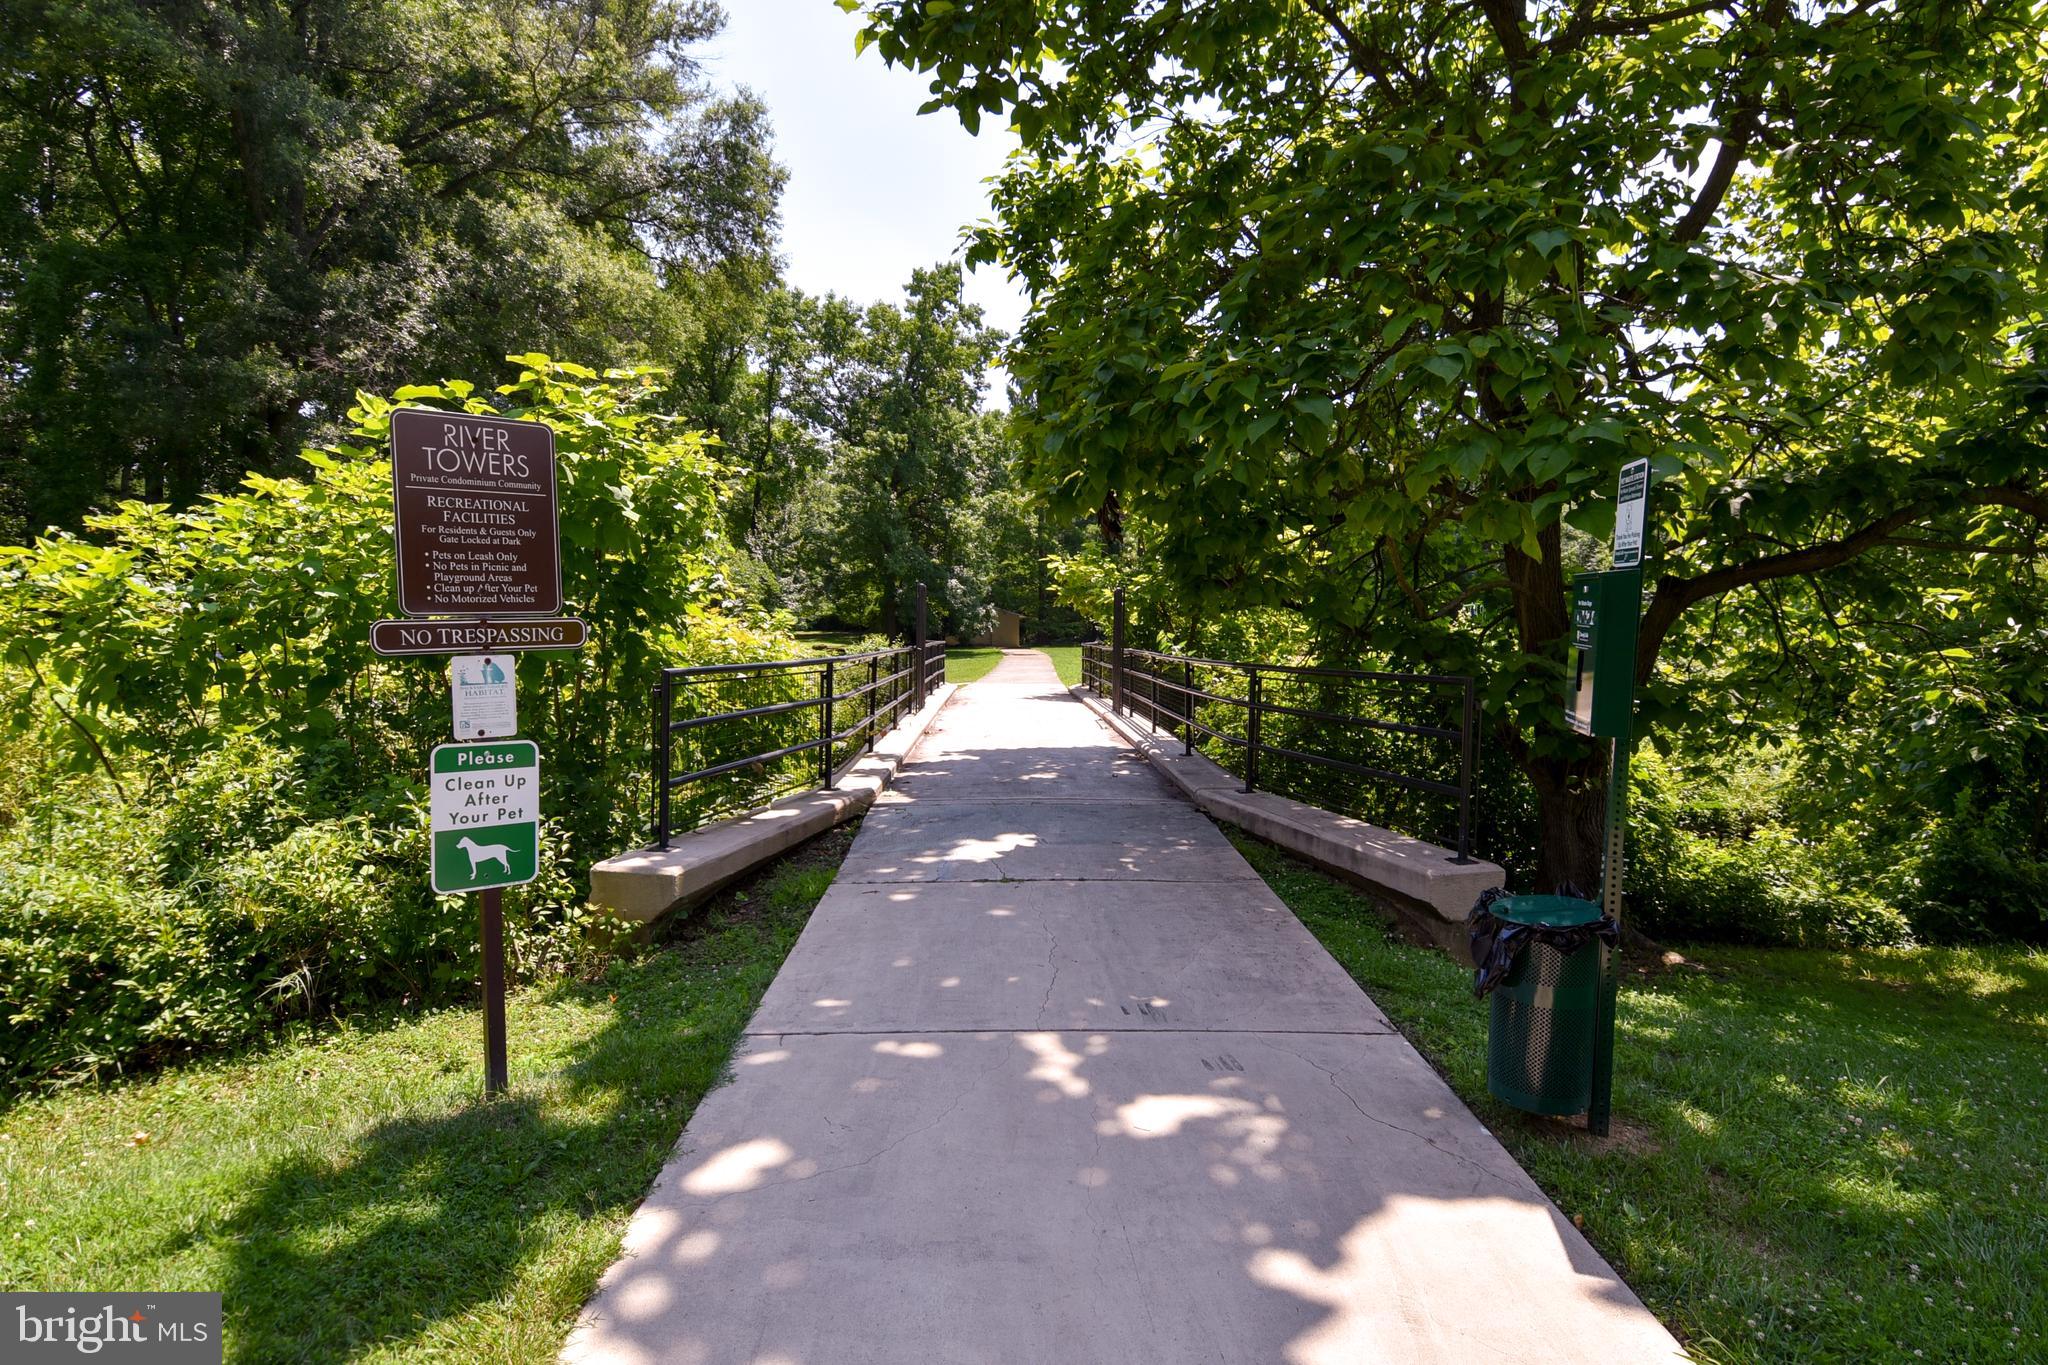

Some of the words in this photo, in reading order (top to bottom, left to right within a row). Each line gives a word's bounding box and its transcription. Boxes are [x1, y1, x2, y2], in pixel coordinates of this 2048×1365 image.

[444, 424, 510, 452] RIVER
[422, 447, 529, 477] TOWERS
[410, 473, 438, 483] Private
[441, 476, 496, 487] Condominium
[498, 480, 541, 491] Community
[427, 496, 529, 512] RECREATIONAL
[444, 511, 515, 524] FACILITIES
[422, 525, 436, 533] For
[439, 526, 477, 534] Residents
[518, 529, 536, 539] Only
[440, 535, 459, 544] Gate
[461, 536, 490, 544] Locked
[432, 551, 451, 559] Pets
[468, 552, 494, 560] Leash
[497, 552, 518, 563] Only
[433, 562, 447, 570] No
[450, 562, 468, 570] Pets
[482, 563, 509, 571] Picnic
[512, 563, 527, 572] and
[434, 573, 485, 583] Playground
[434, 584, 460, 592] Clean
[463, 585, 474, 594] up
[501, 584, 522, 592] Your
[525, 584, 538, 592] Pet
[435, 595, 448, 603] No
[452, 595, 497, 603] Motorized
[500, 594, 535, 603] Vehicles
[400, 629, 432, 645] NO
[437, 627, 564, 644] TRESPASSING
[458, 751, 514, 765] Please
[446, 777, 494, 791] Clean
[505, 774, 526, 789] Up
[464, 792, 508, 807] After
[449, 812, 488, 824] Your
[498, 808, 523, 820] Pet
